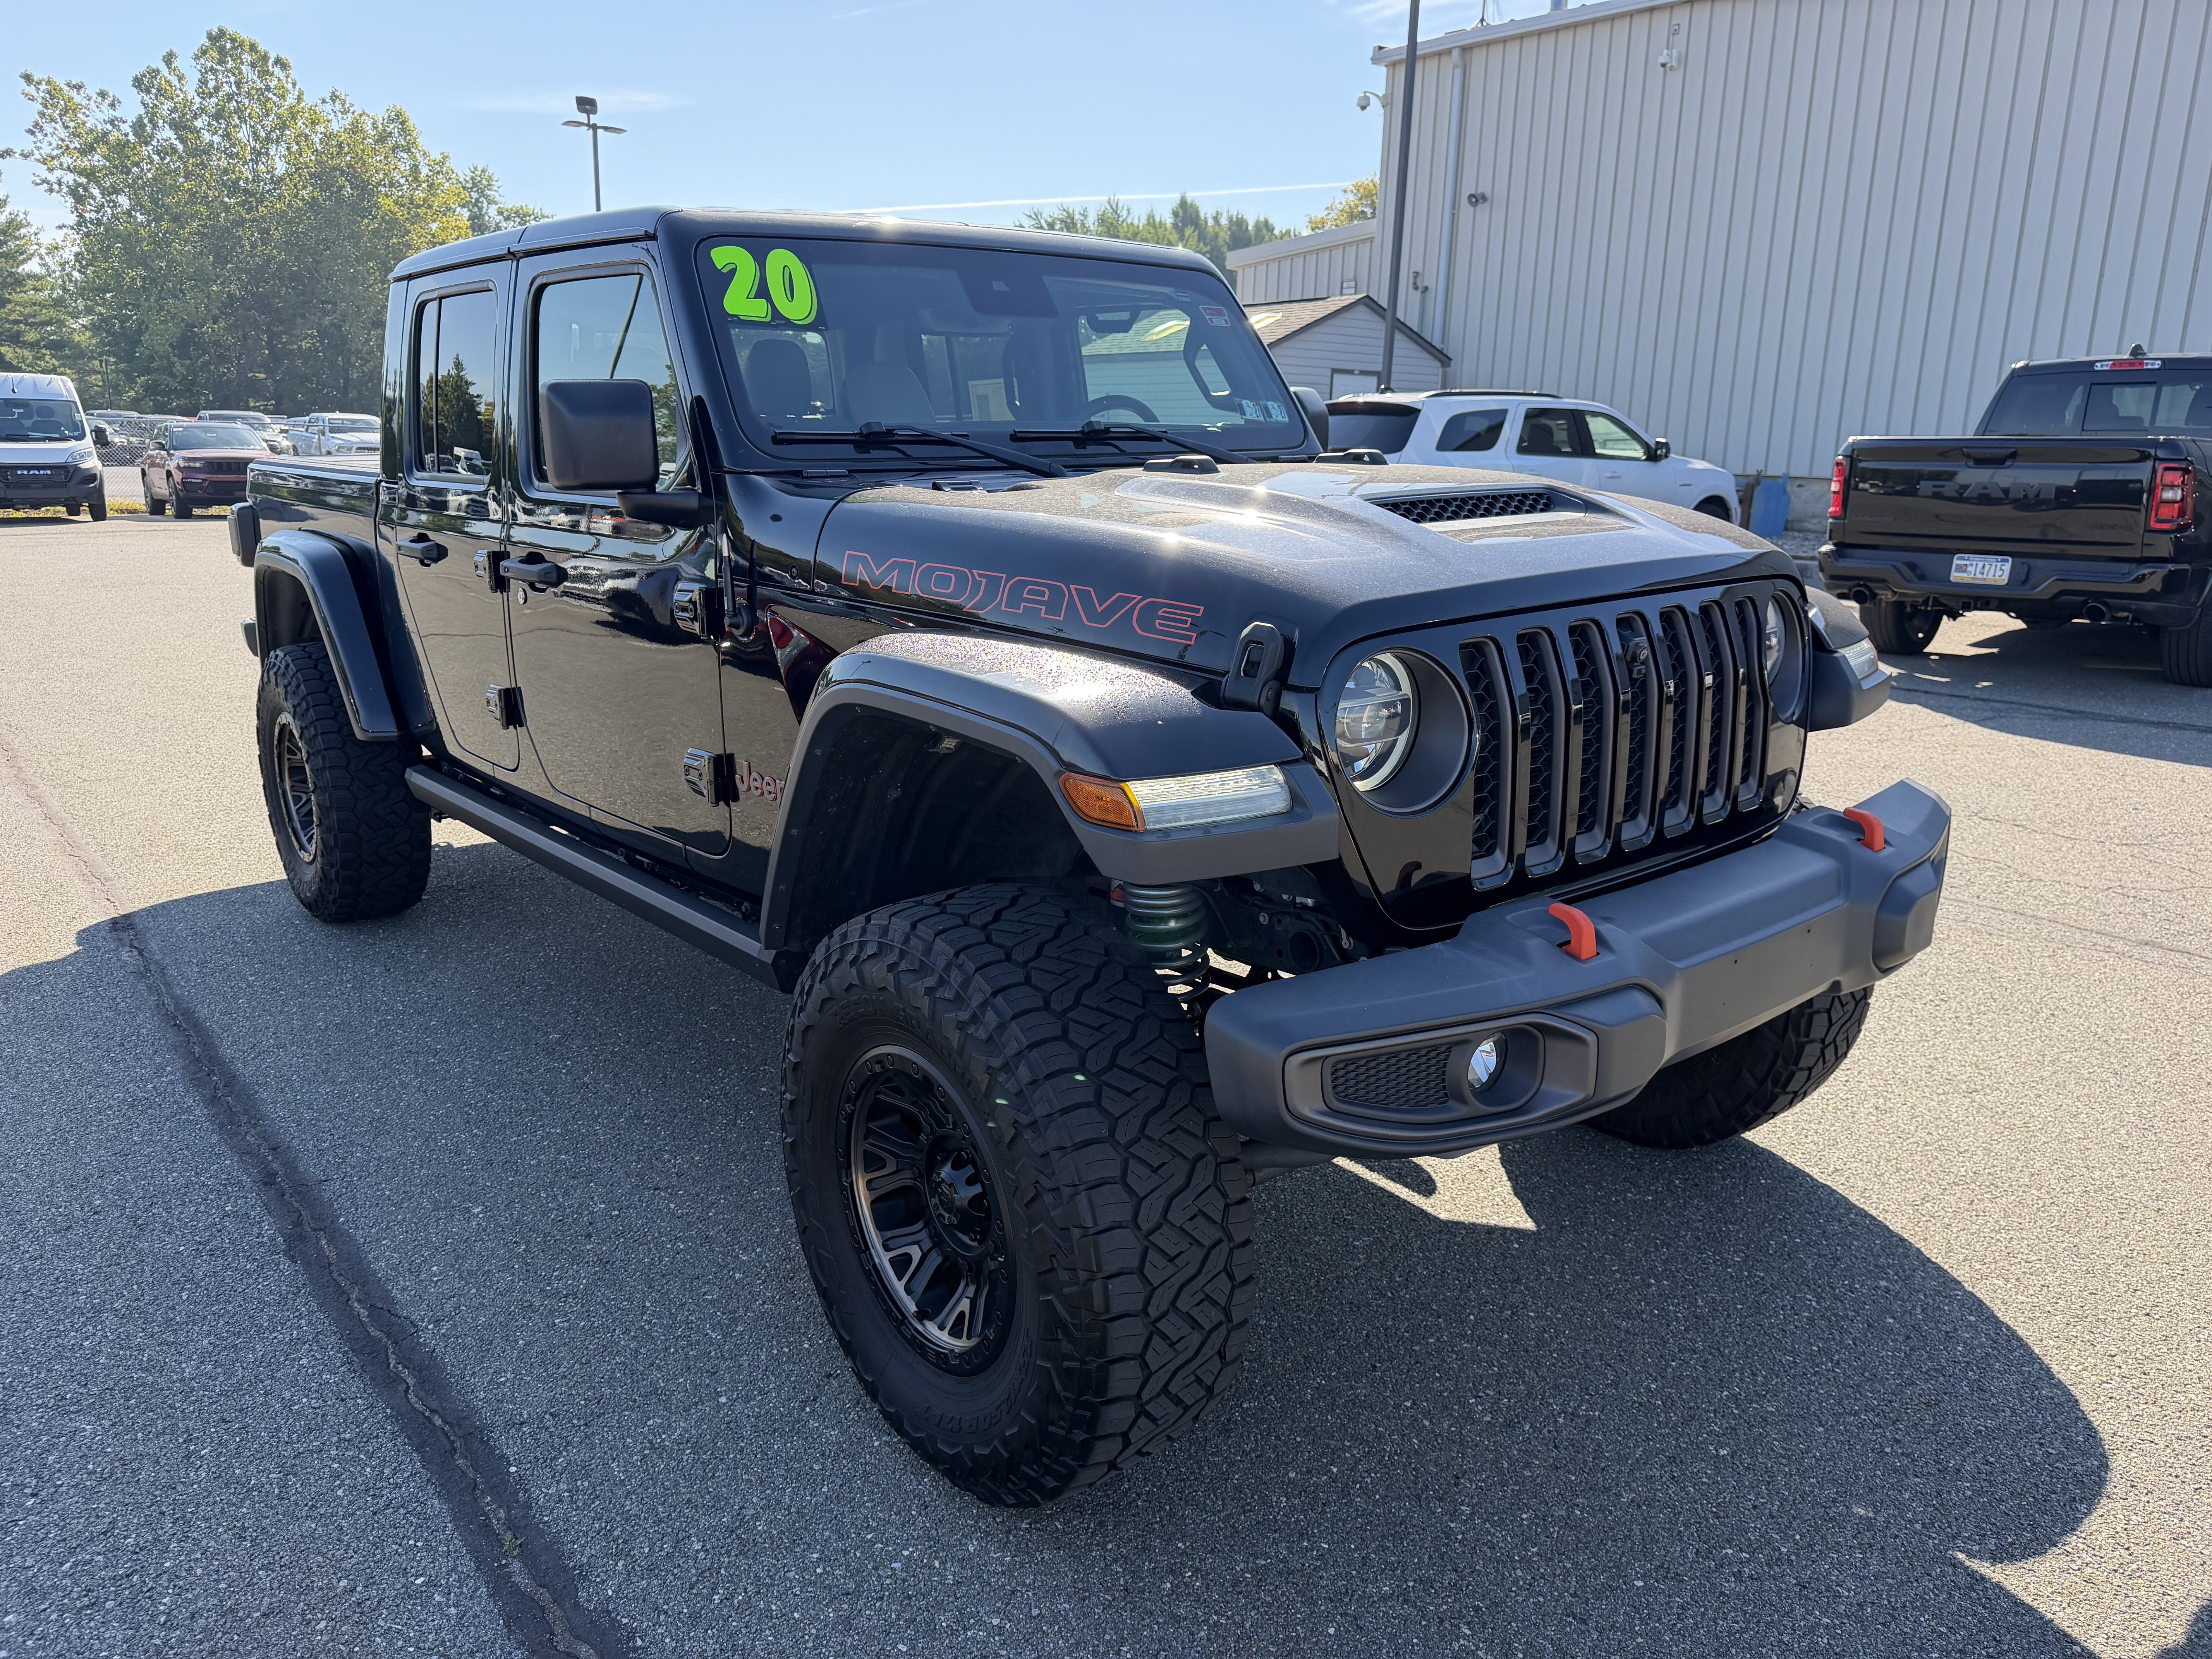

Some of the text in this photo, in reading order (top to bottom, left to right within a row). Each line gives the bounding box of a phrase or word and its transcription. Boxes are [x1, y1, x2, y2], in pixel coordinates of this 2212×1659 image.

[710, 246, 818, 325] 20
[1918, 480, 2056, 500] RAM
[1973, 562, 2006, 578] 14715
[841, 550, 1204, 645] MOJAVE
